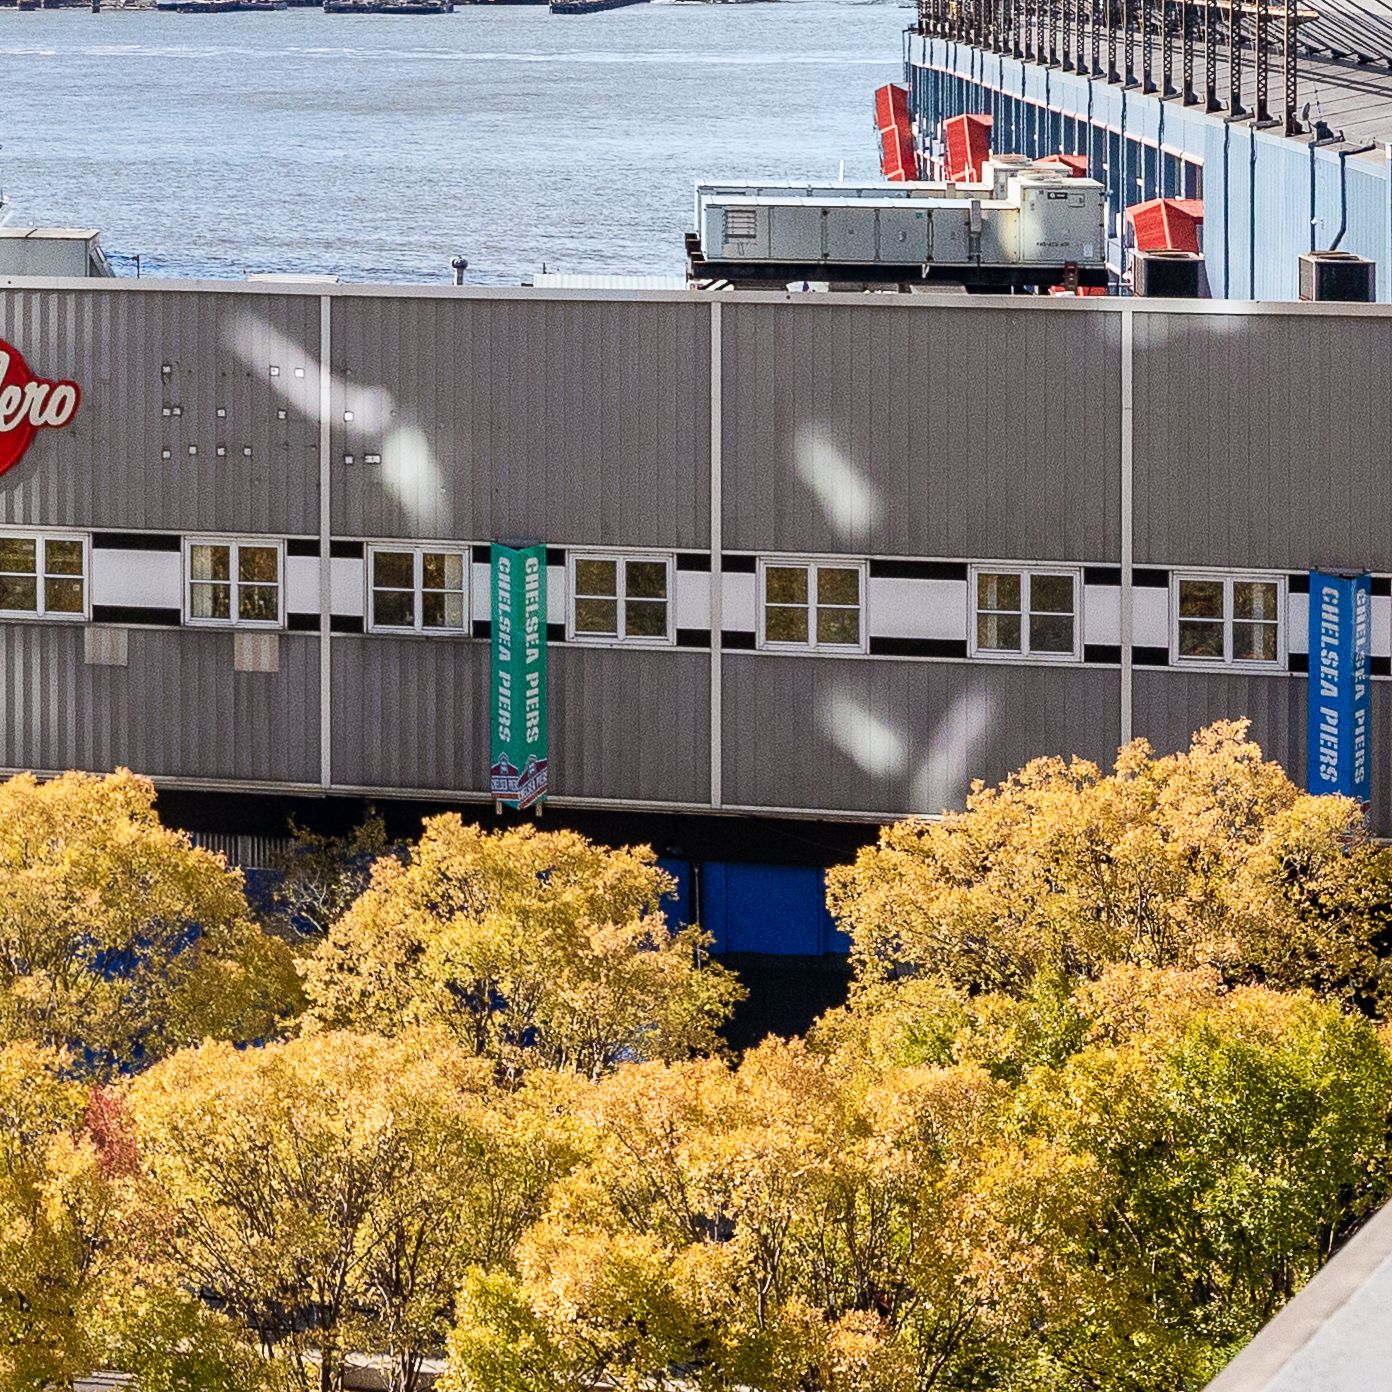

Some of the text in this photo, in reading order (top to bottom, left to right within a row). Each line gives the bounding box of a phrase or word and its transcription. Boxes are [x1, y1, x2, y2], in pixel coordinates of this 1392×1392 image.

[498, 556, 511, 743] CHELSEA PIERS
[525, 556, 539, 744] CHELSEA PIERS
[1319, 586, 1339, 783] CHELSEA PIERS
[1354, 588, 1366, 785] CHELSEA PIERS
